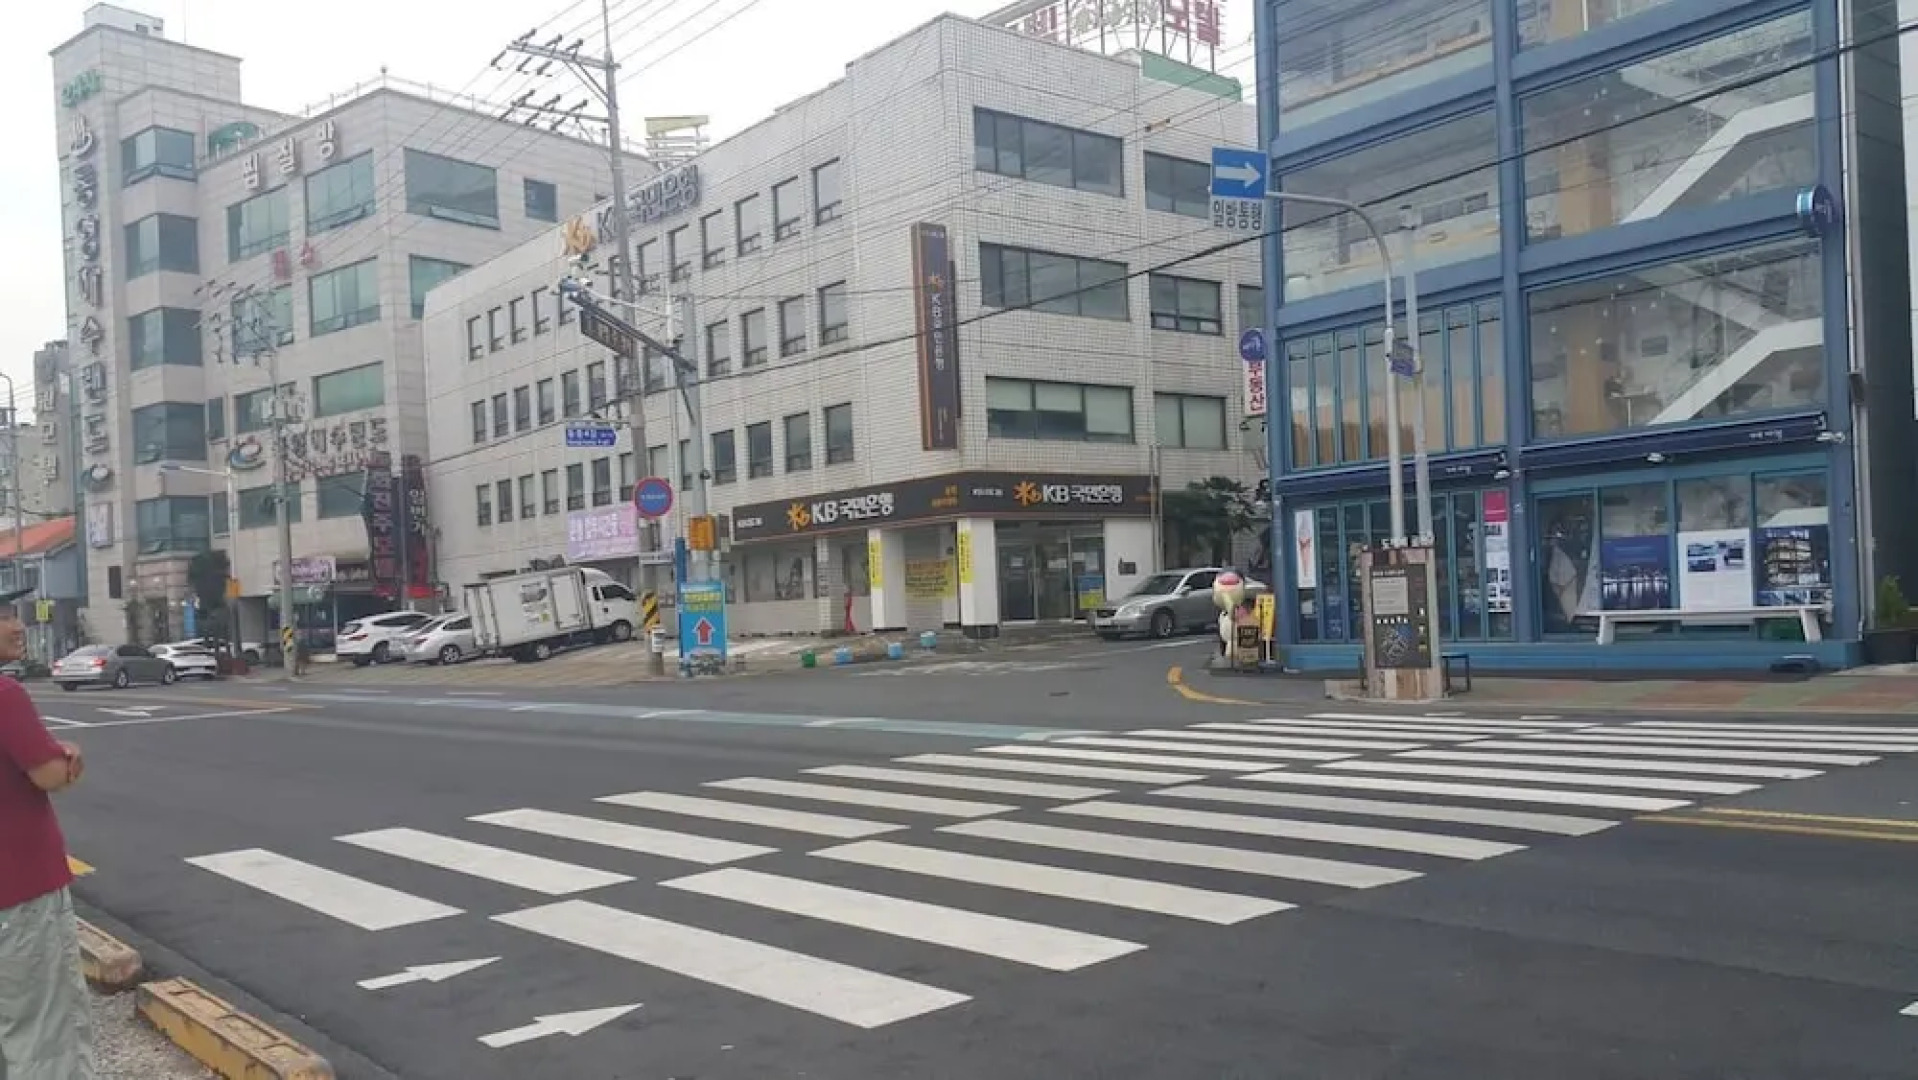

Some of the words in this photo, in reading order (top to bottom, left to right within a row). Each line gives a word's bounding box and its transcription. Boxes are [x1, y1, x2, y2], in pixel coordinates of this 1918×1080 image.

[243, 119, 336, 190] 찜질방
[1213, 199, 1262, 231] 일방통행
[1248, 361, 1265, 412] 부동산
[811, 492, 893, 525] KB국민은행
[1042, 484, 1122, 504] KB국민은행
